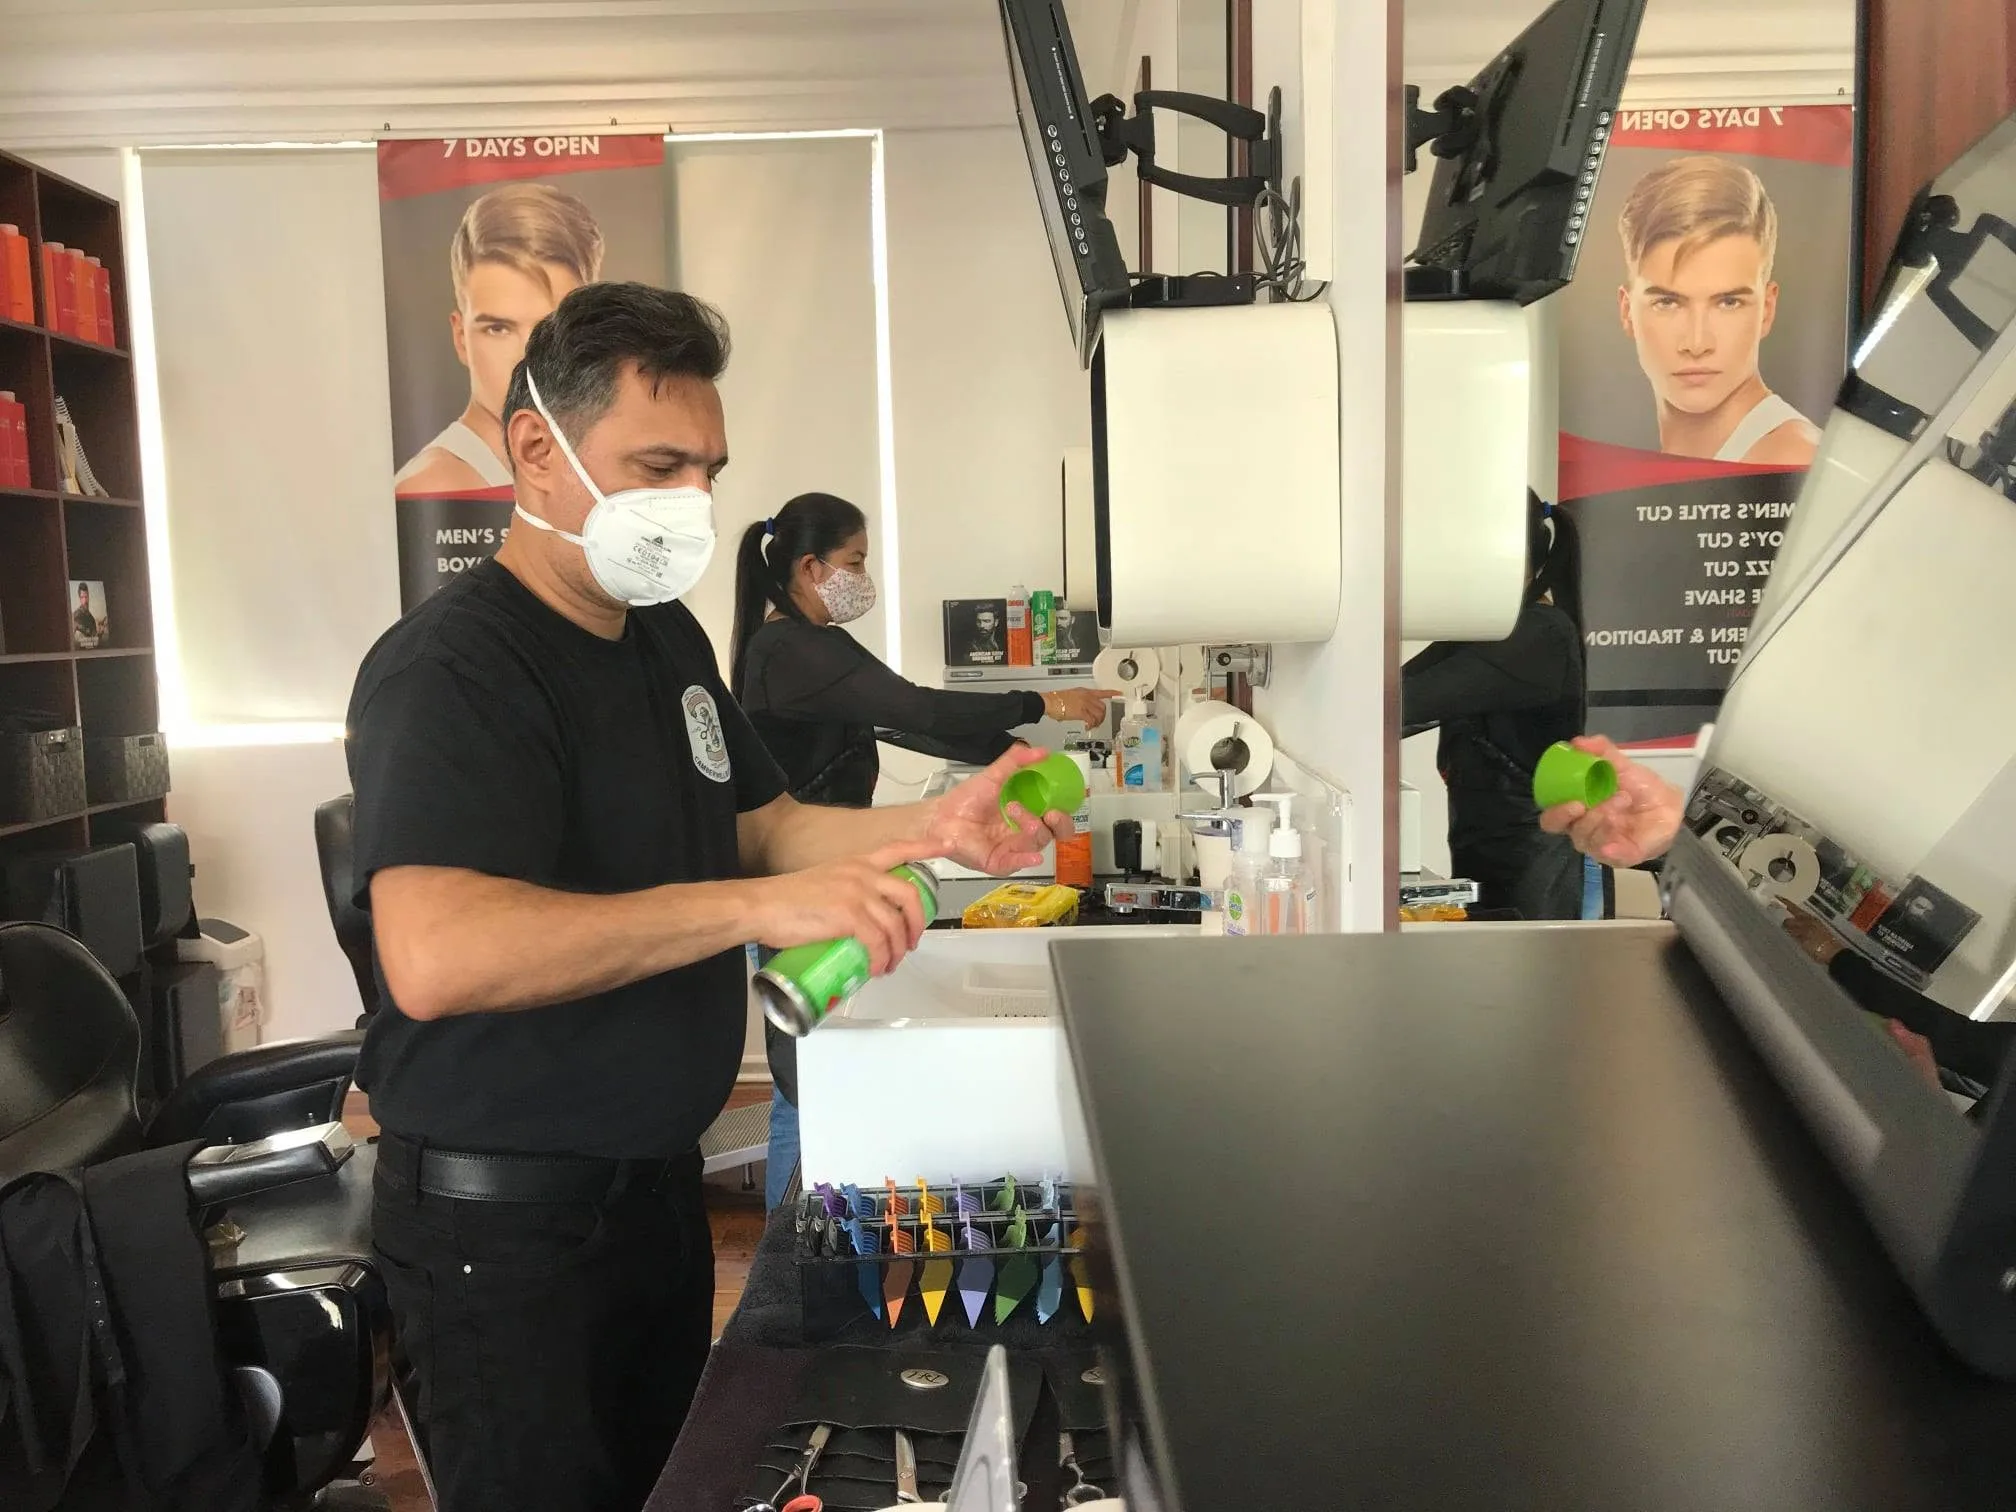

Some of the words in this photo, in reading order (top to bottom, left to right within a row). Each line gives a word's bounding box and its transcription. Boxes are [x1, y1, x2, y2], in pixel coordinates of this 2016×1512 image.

[443, 138, 458, 158] 7
[465, 136, 527, 157] DAYS
[533, 135, 600, 156] OPEN
[436, 528, 495, 544] MEN'S
[437, 556, 482, 573] BOY'
